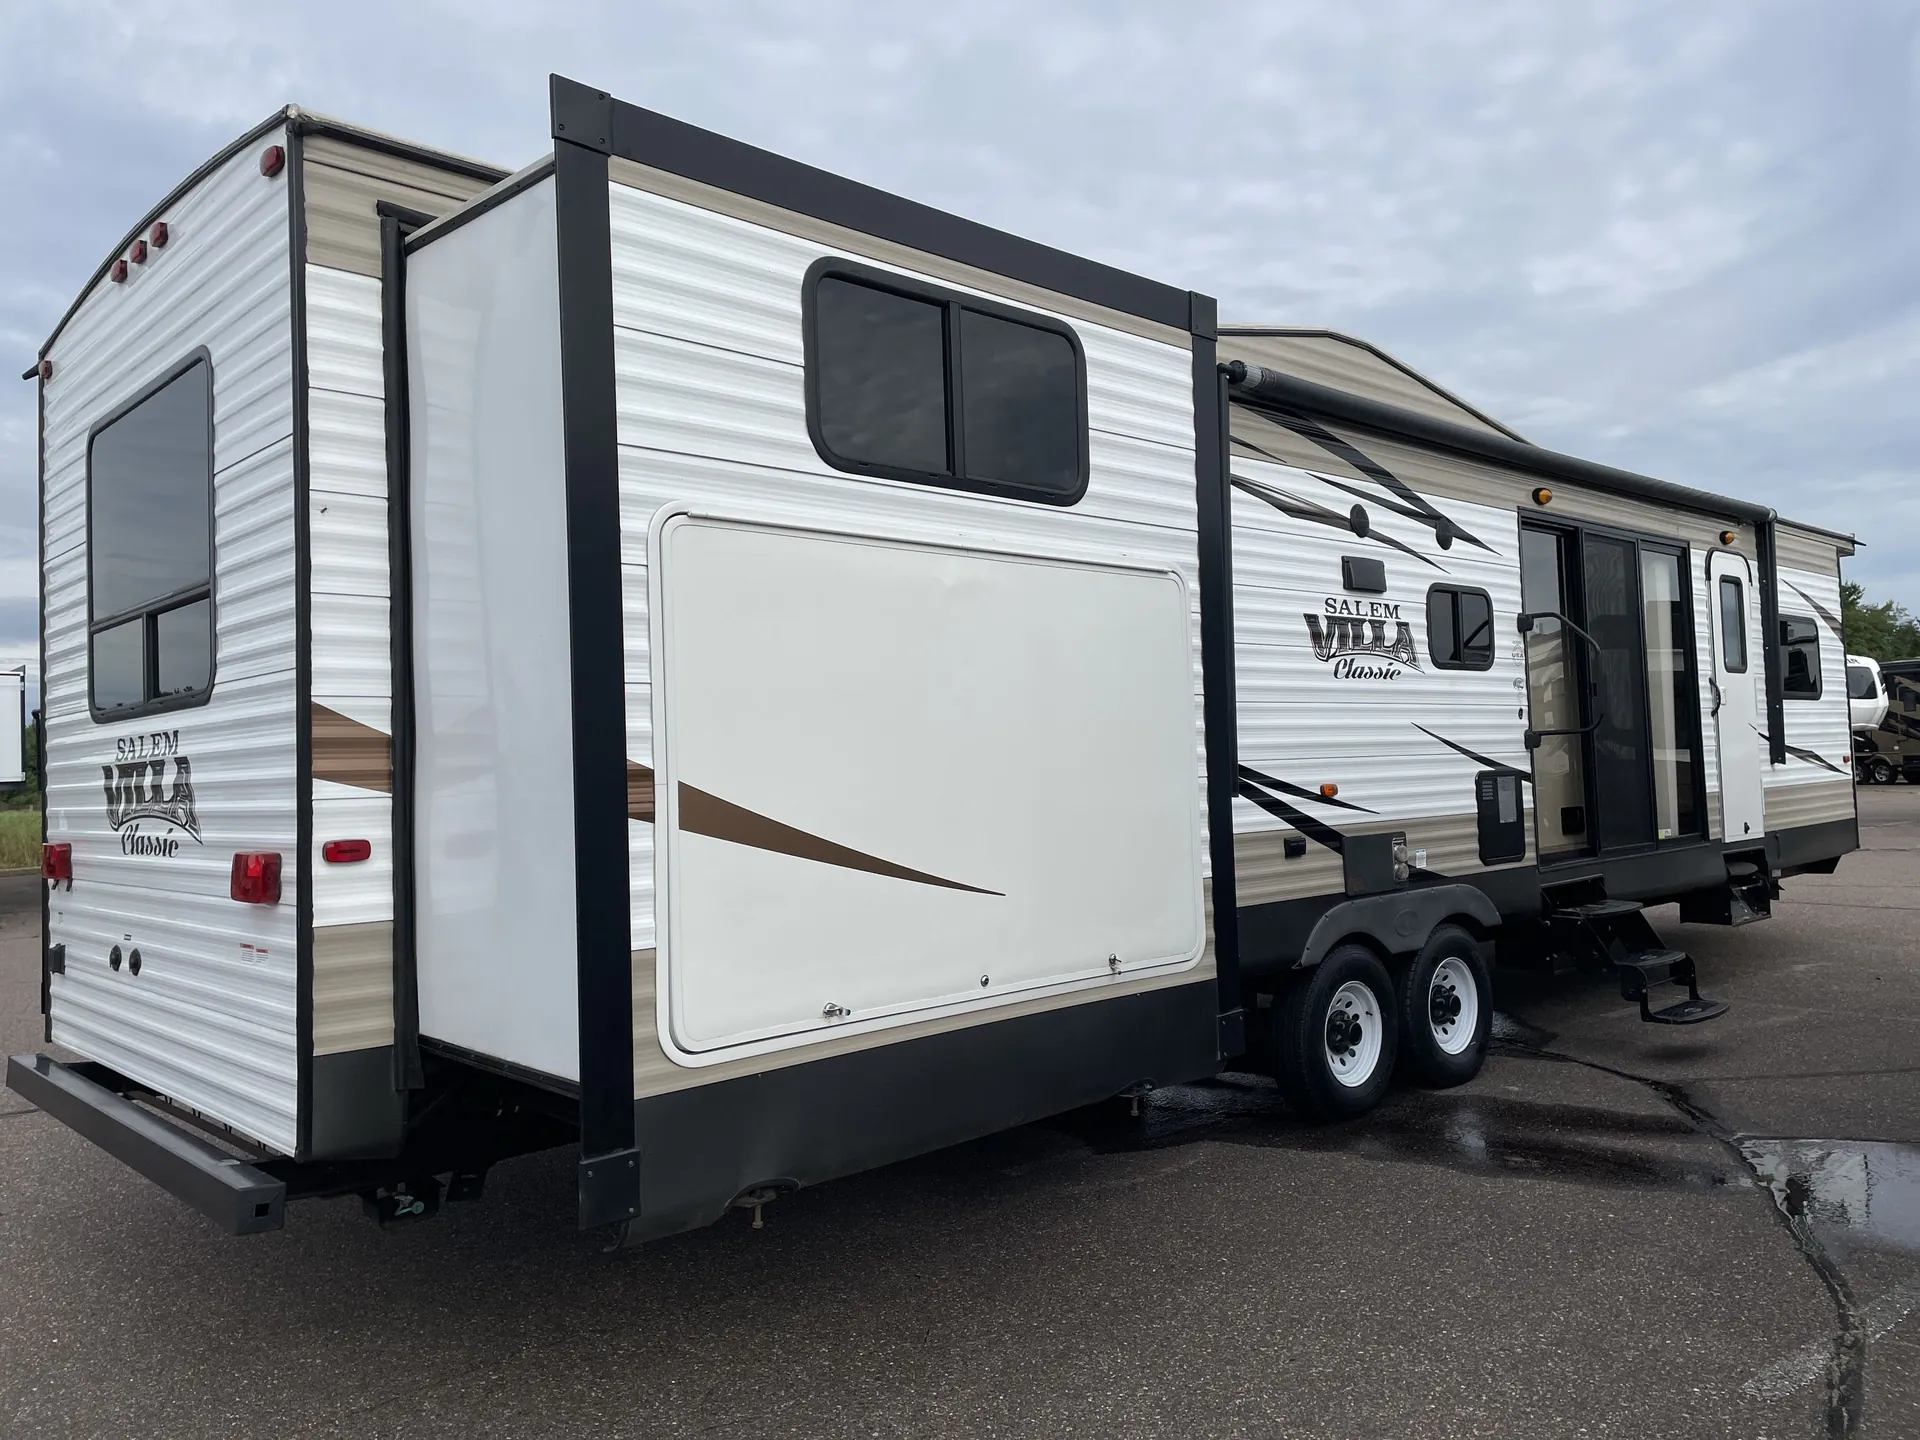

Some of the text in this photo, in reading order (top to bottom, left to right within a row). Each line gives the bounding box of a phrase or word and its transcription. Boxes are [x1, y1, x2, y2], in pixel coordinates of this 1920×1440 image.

[1324, 597, 1401, 620] SALEM
[1303, 613, 1425, 674] VILLA
[1333, 658, 1401, 680] Classic
[115, 730, 179, 762] SALEM
[101, 756, 203, 845] VILLA
[121, 823, 179, 859] Classic
